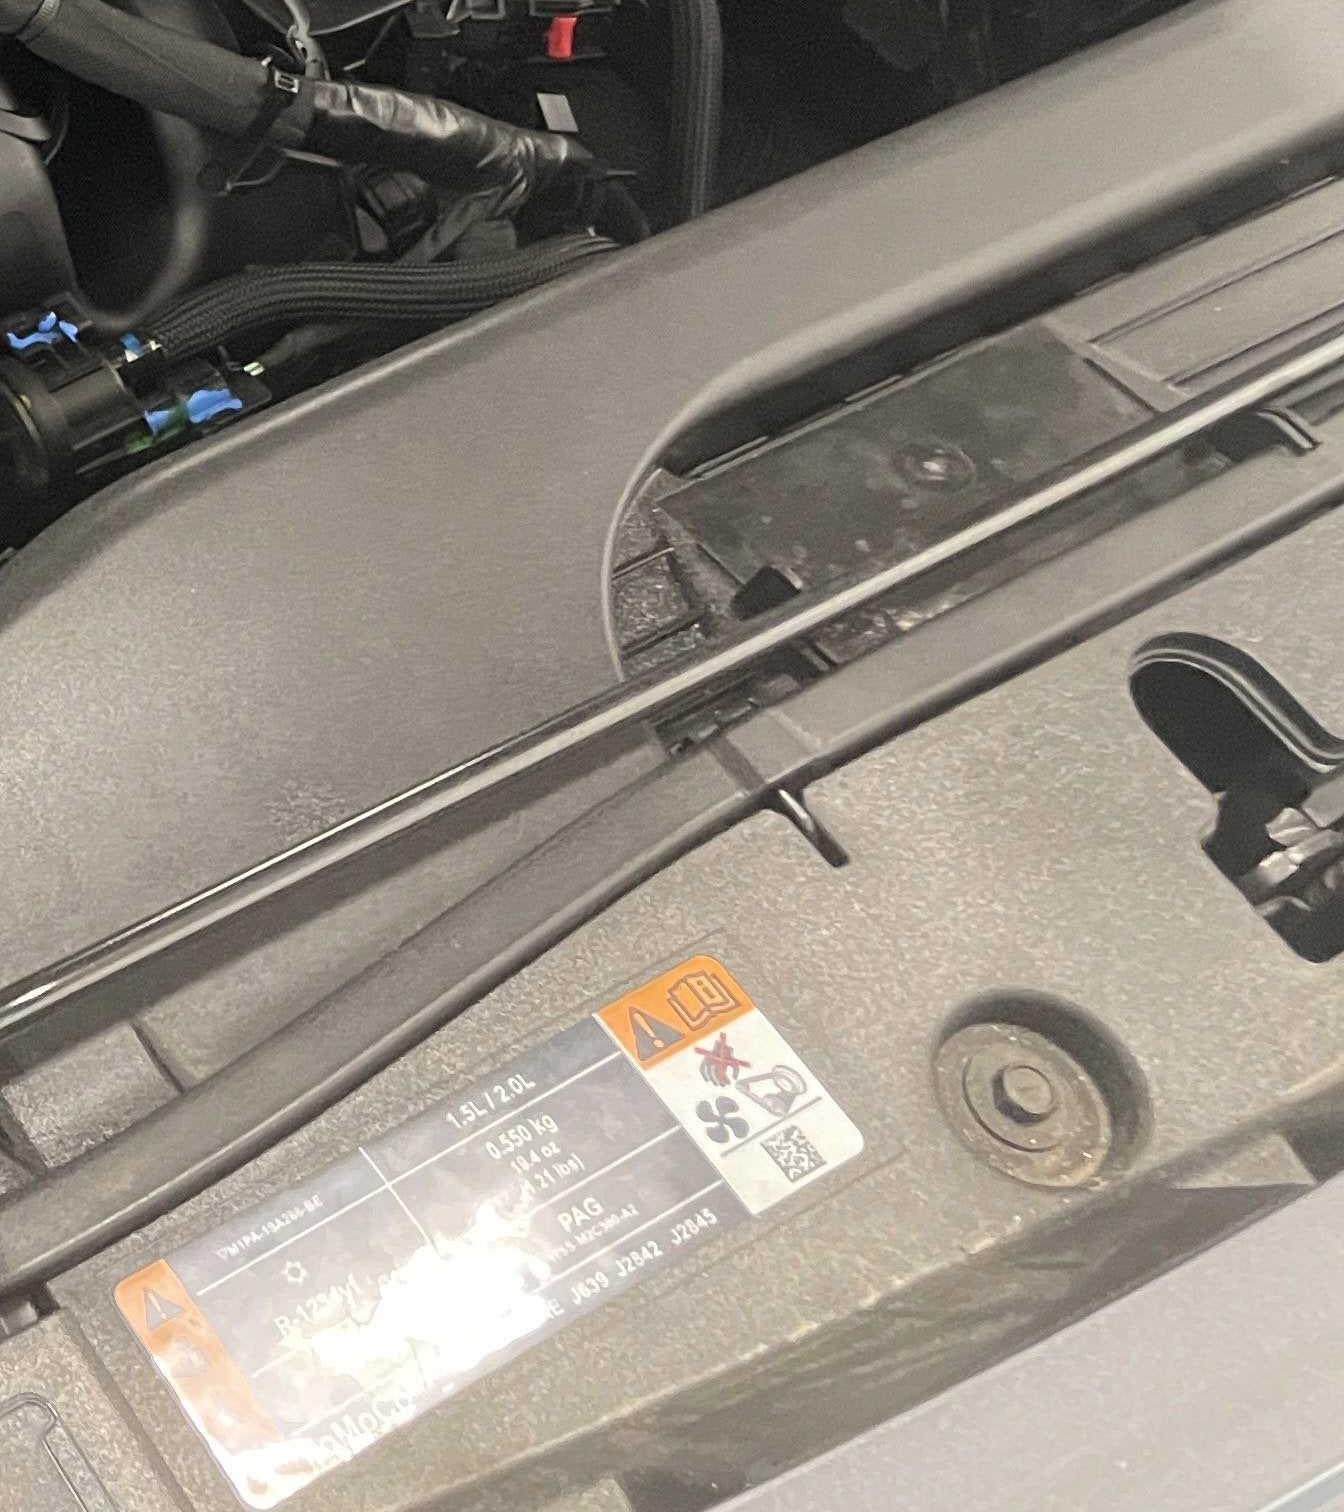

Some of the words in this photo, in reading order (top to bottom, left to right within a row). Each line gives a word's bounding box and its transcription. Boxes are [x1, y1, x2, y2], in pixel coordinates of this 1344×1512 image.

[446, 1102, 488, 1128] 1.5L
[493, 1074, 536, 1103] 2.0L
[485, 1124, 532, 1159] 0.550
[527, 1115, 558, 1136] kg
[540, 1141, 561, 1158] oz
[557, 1197, 605, 1233] PAG
[569, 1271, 610, 1305] J639
[615, 1240, 664, 1278] J2842
[670, 1208, 718, 1246] J2845
